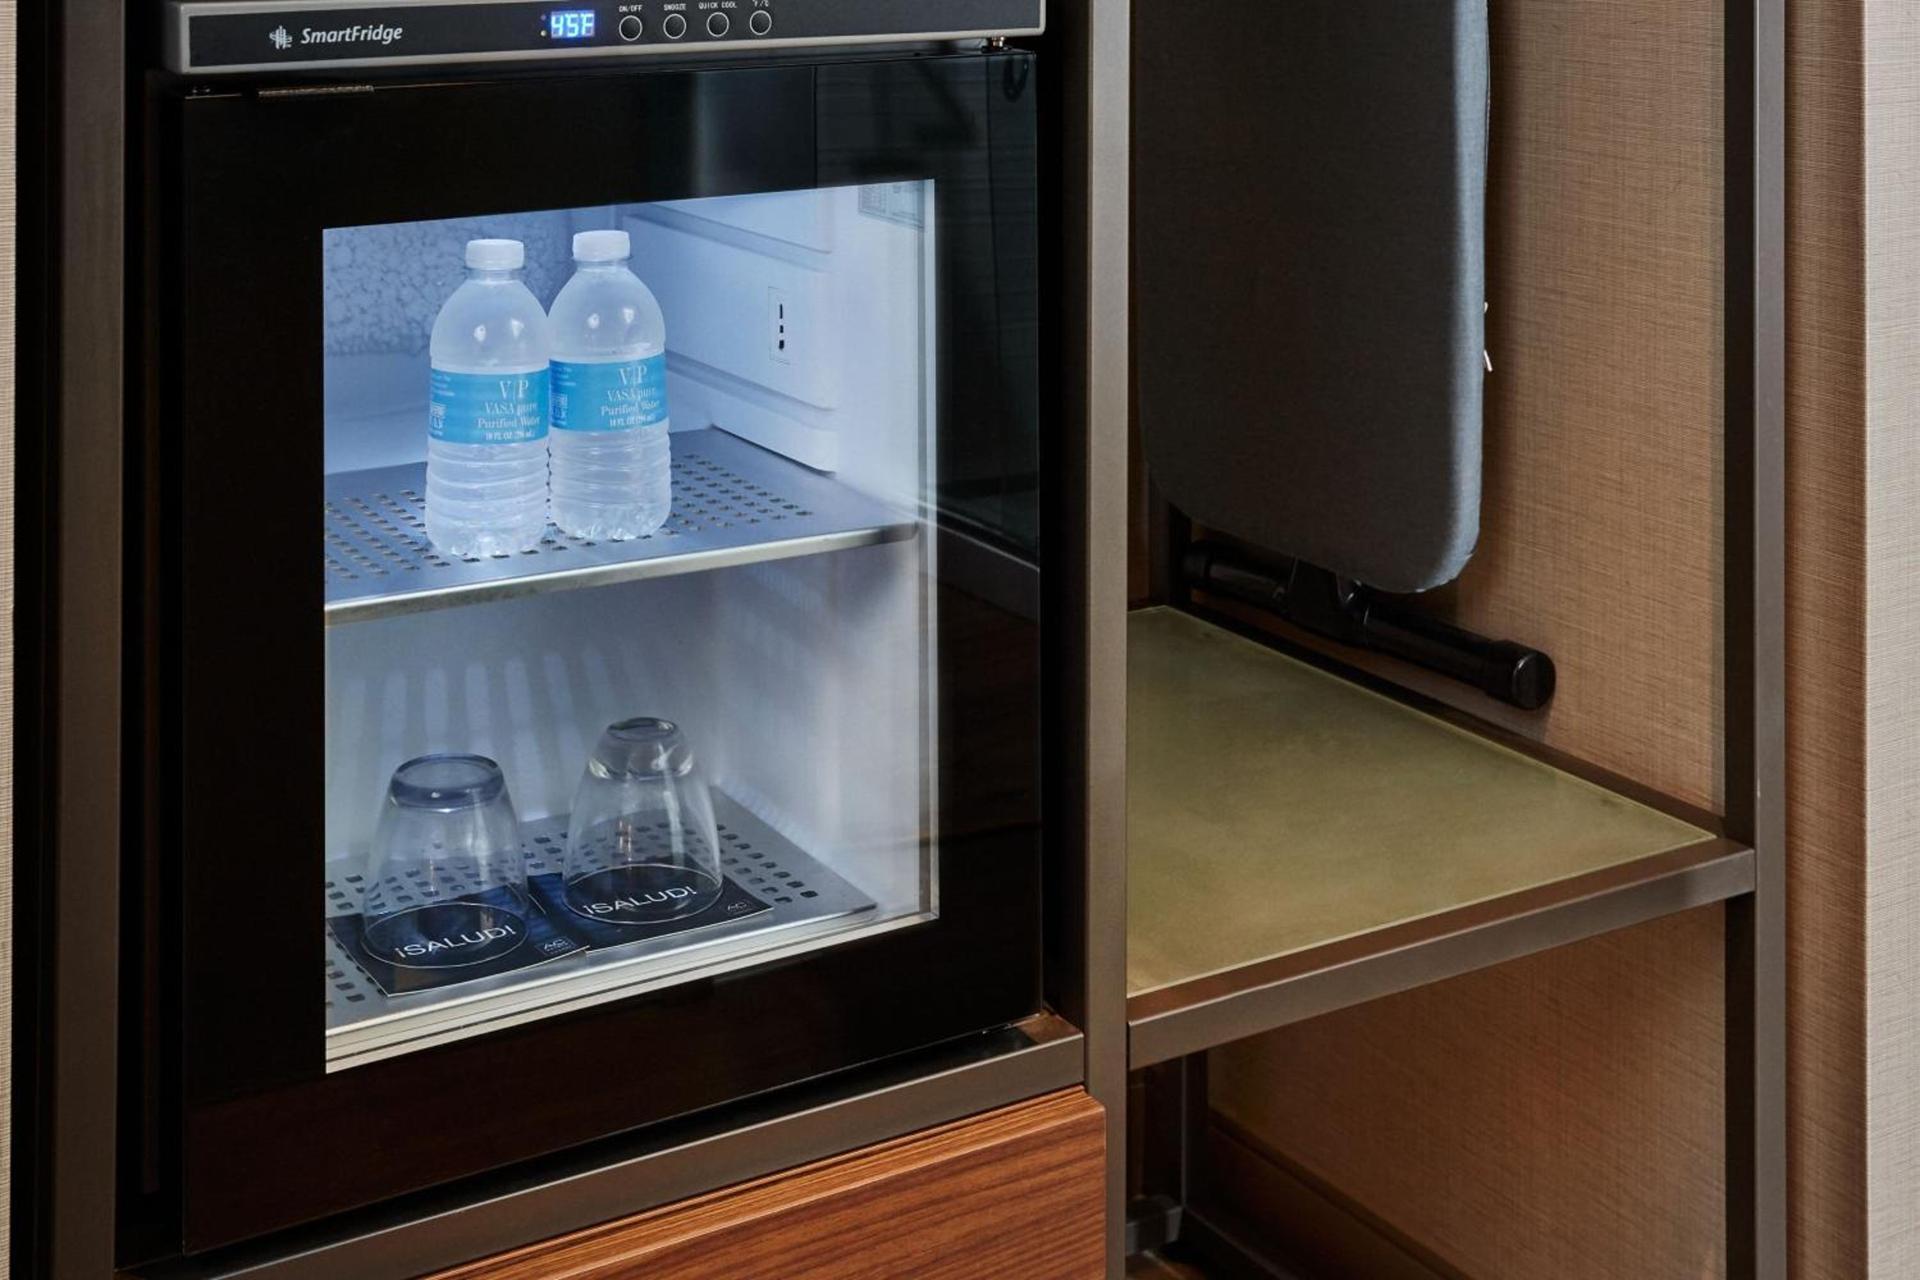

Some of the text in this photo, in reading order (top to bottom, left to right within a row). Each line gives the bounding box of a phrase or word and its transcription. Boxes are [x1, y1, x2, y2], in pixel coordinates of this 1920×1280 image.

[698, 1, 738, 10] QUICK COOL
[300, 24, 403, 45] SmartFridge
[600, 402, 639, 417] Purified
[477, 417, 517, 429] Purified
